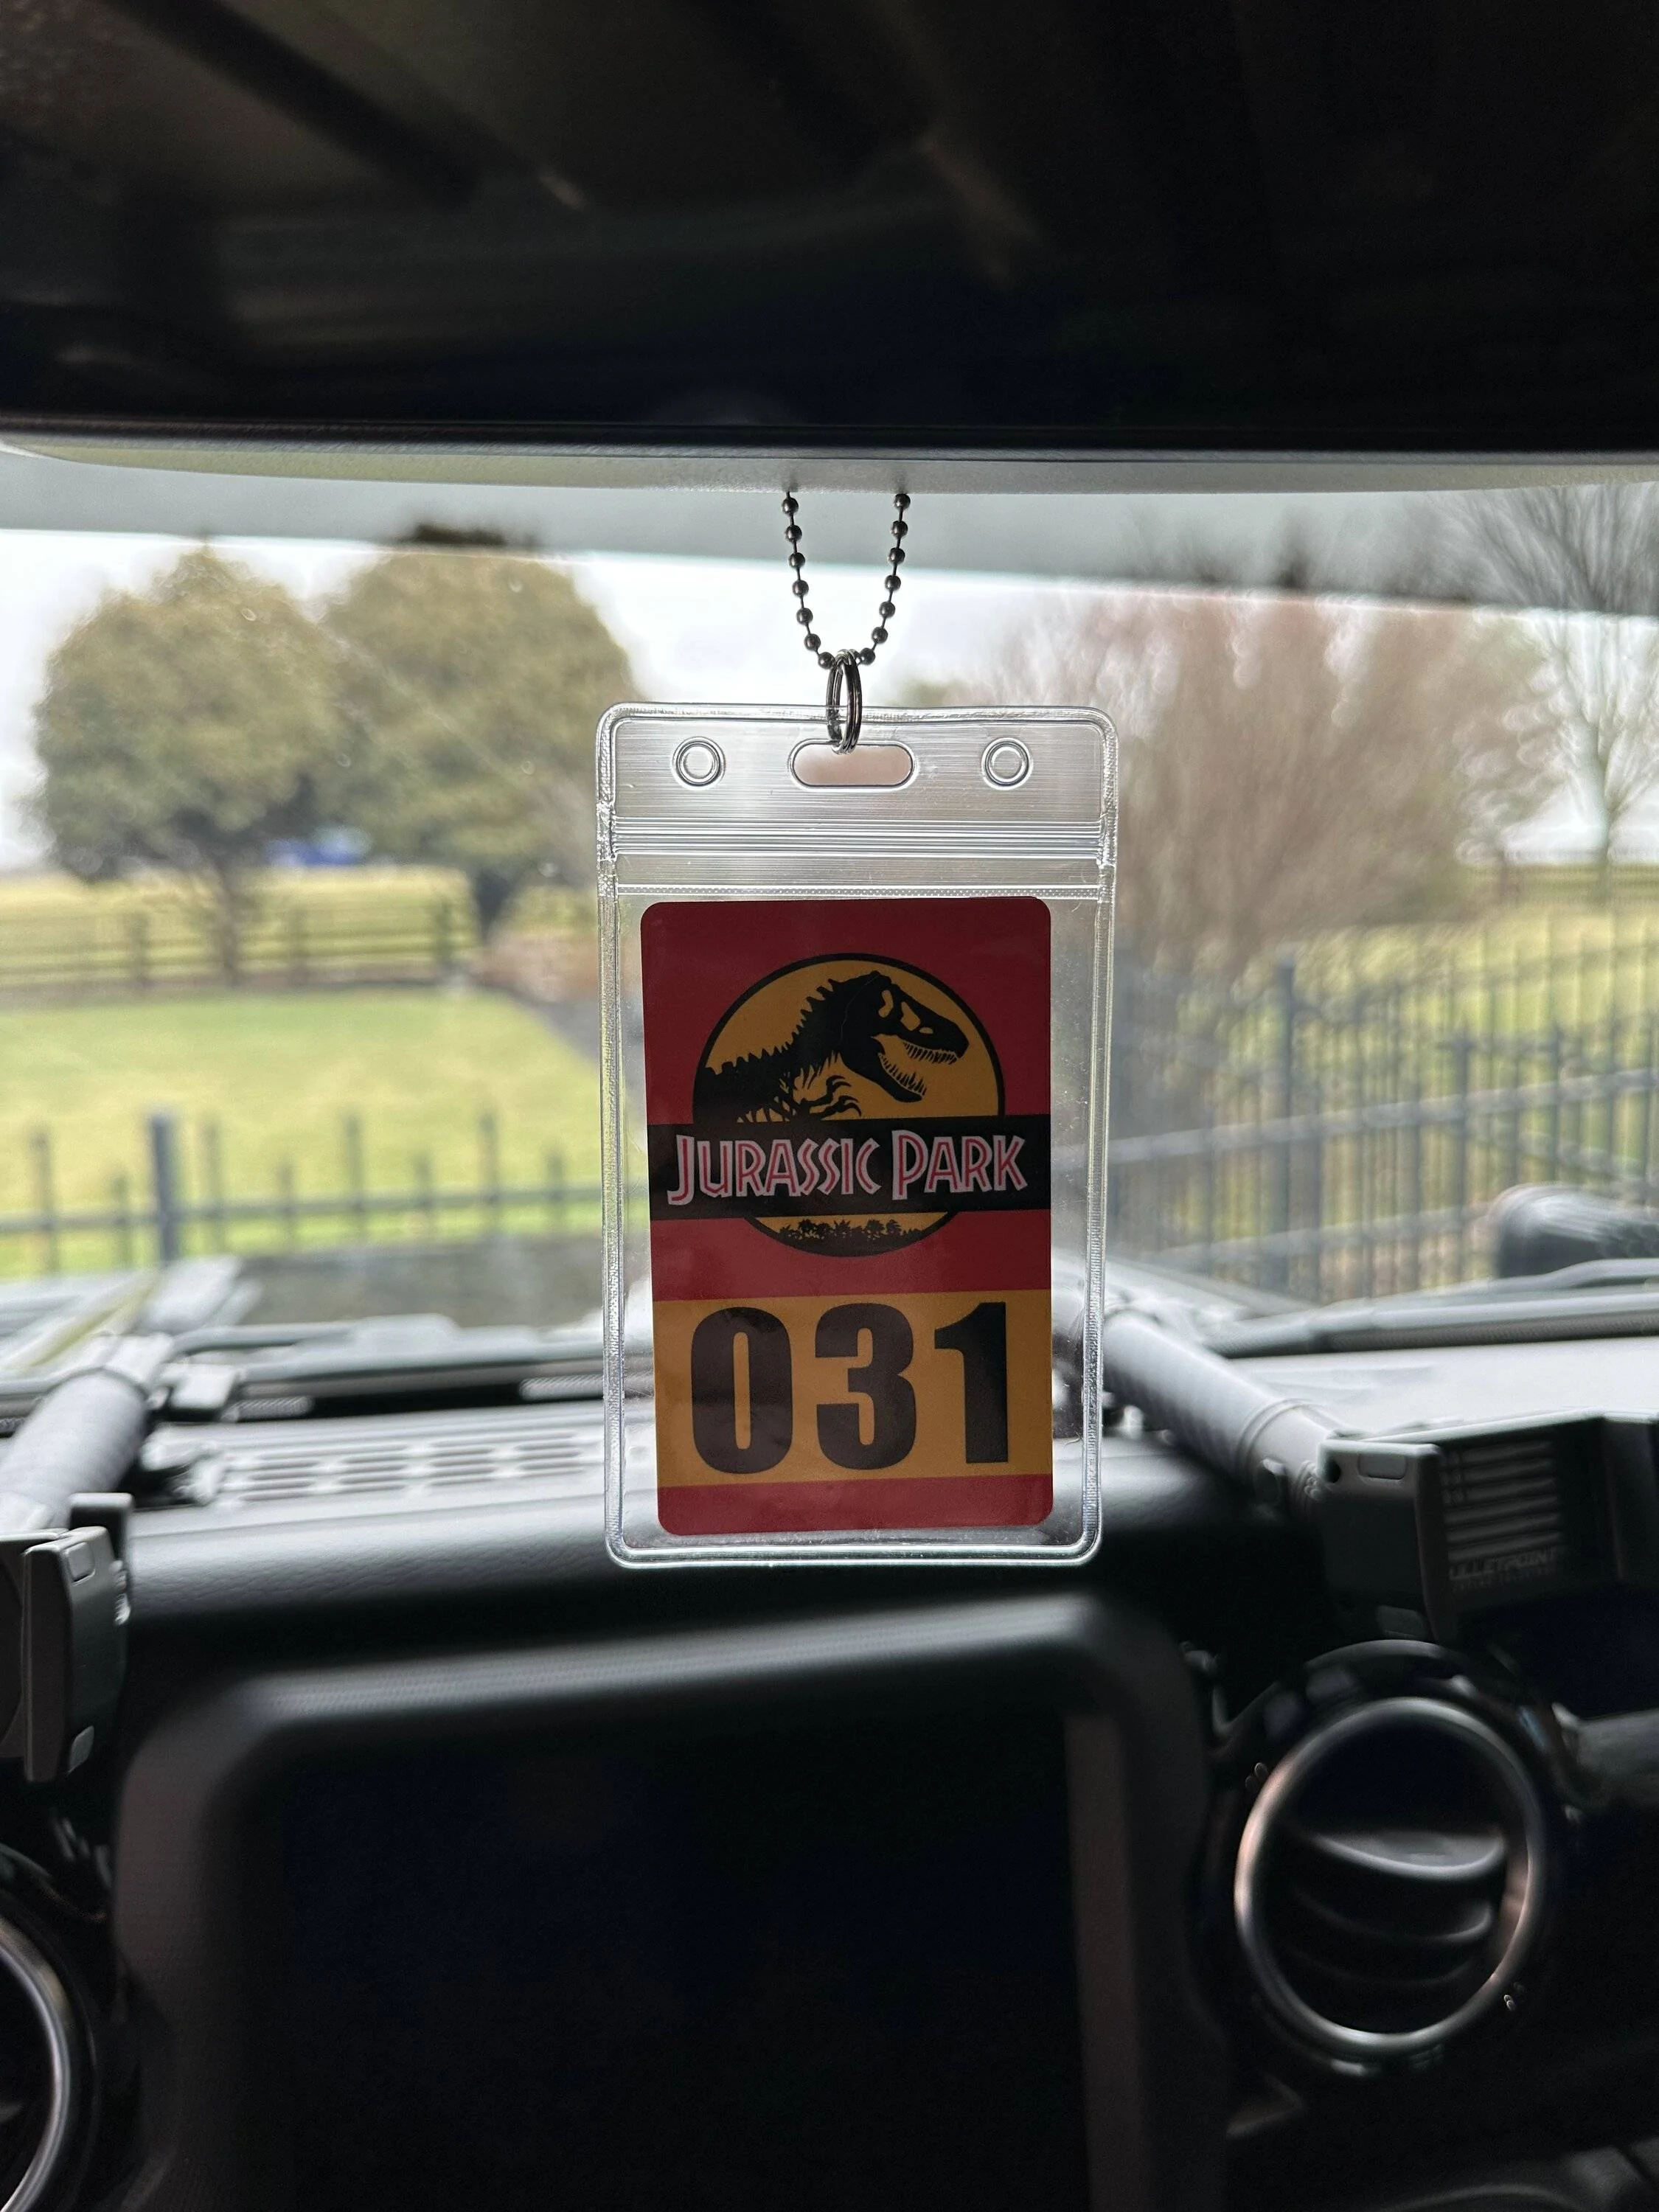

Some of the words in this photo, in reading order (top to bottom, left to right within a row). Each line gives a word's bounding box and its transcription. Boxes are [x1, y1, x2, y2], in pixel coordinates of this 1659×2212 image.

[667, 1134, 882, 1206] JURASSIC
[891, 1130, 1029, 1200] PARK
[690, 1301, 1009, 1475] 031
